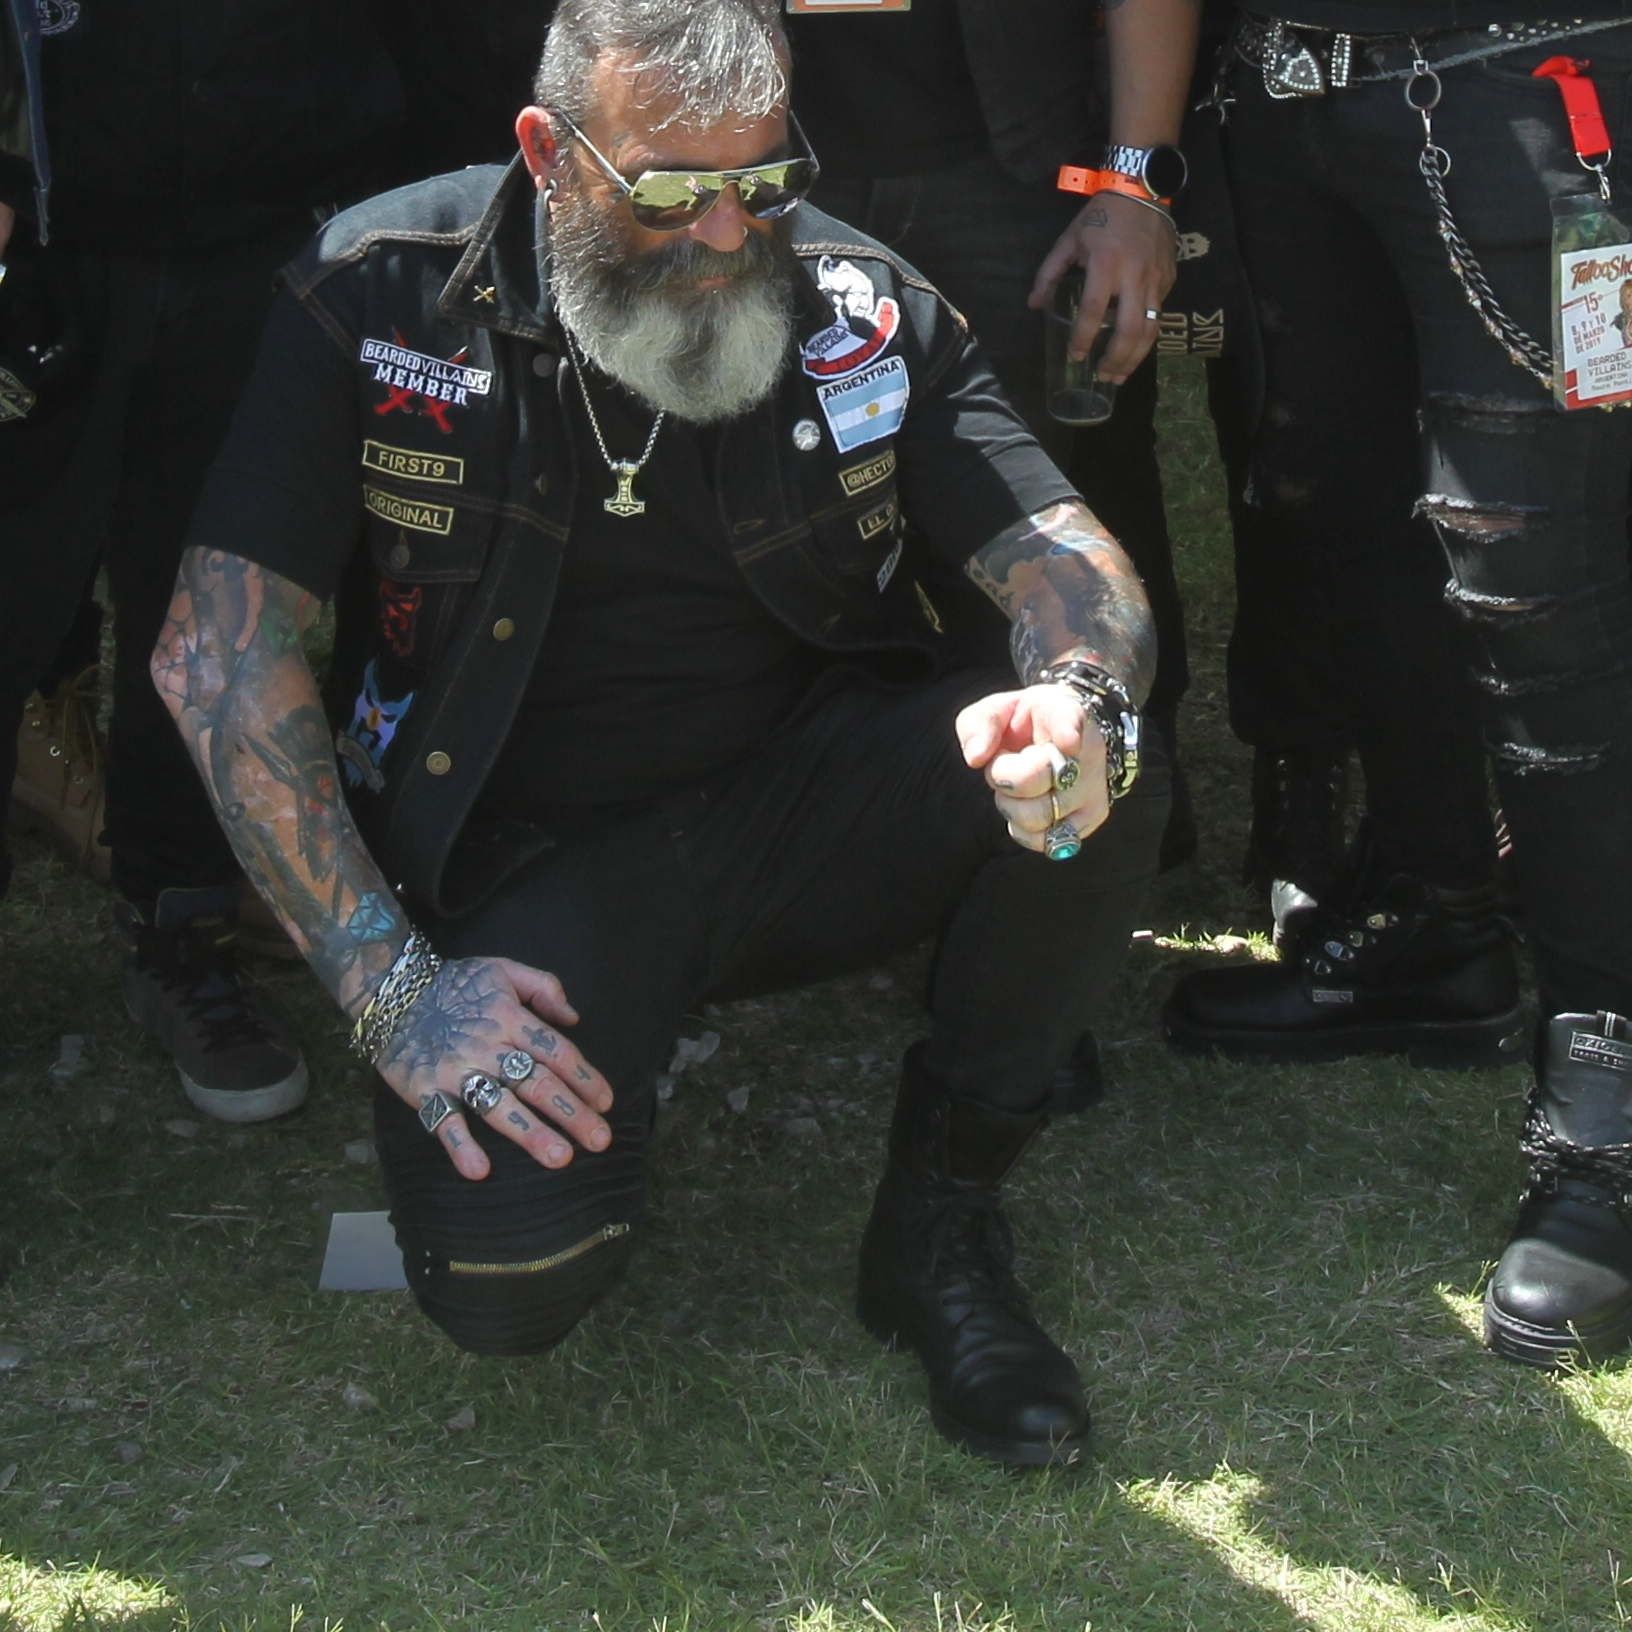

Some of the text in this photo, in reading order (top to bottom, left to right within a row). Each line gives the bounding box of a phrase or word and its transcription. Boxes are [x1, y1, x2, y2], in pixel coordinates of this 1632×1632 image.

[374, 362, 468, 406] MEMBER
[823, 360, 901, 401] ARGENTINA
[378, 450, 445, 478] FIRST9
[368, 491, 443, 529] ORIGINAL
